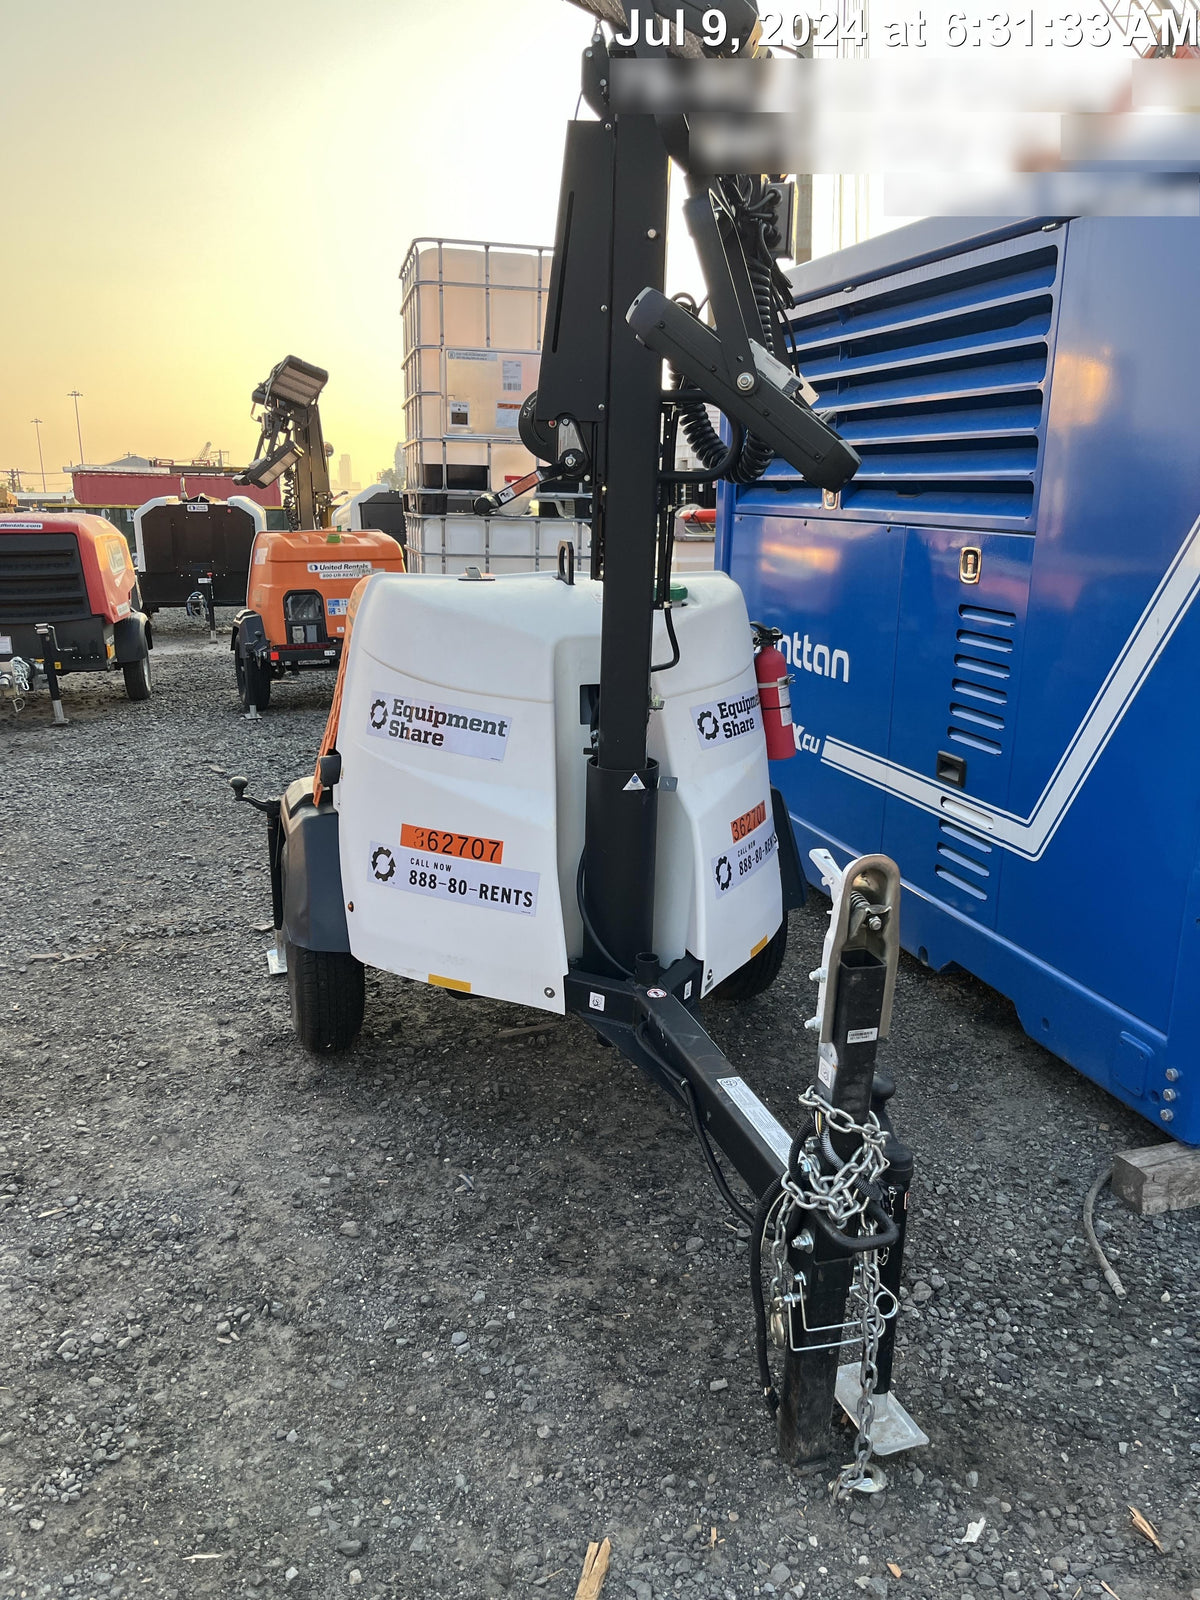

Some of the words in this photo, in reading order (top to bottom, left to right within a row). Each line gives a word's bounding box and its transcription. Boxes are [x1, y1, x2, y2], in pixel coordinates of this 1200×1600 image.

[320, 563, 343, 571] United
[343, 563, 369, 571] Rentals
[391, 698, 508, 738] Equipment
[722, 717, 755, 739] Share
[388, 719, 445, 747] Share
[413, 827, 501, 862] 362707
[409, 856, 430, 868] CALL
[433, 861, 453, 872] NOW
[408, 870, 534, 908] 888-80-RENTS
